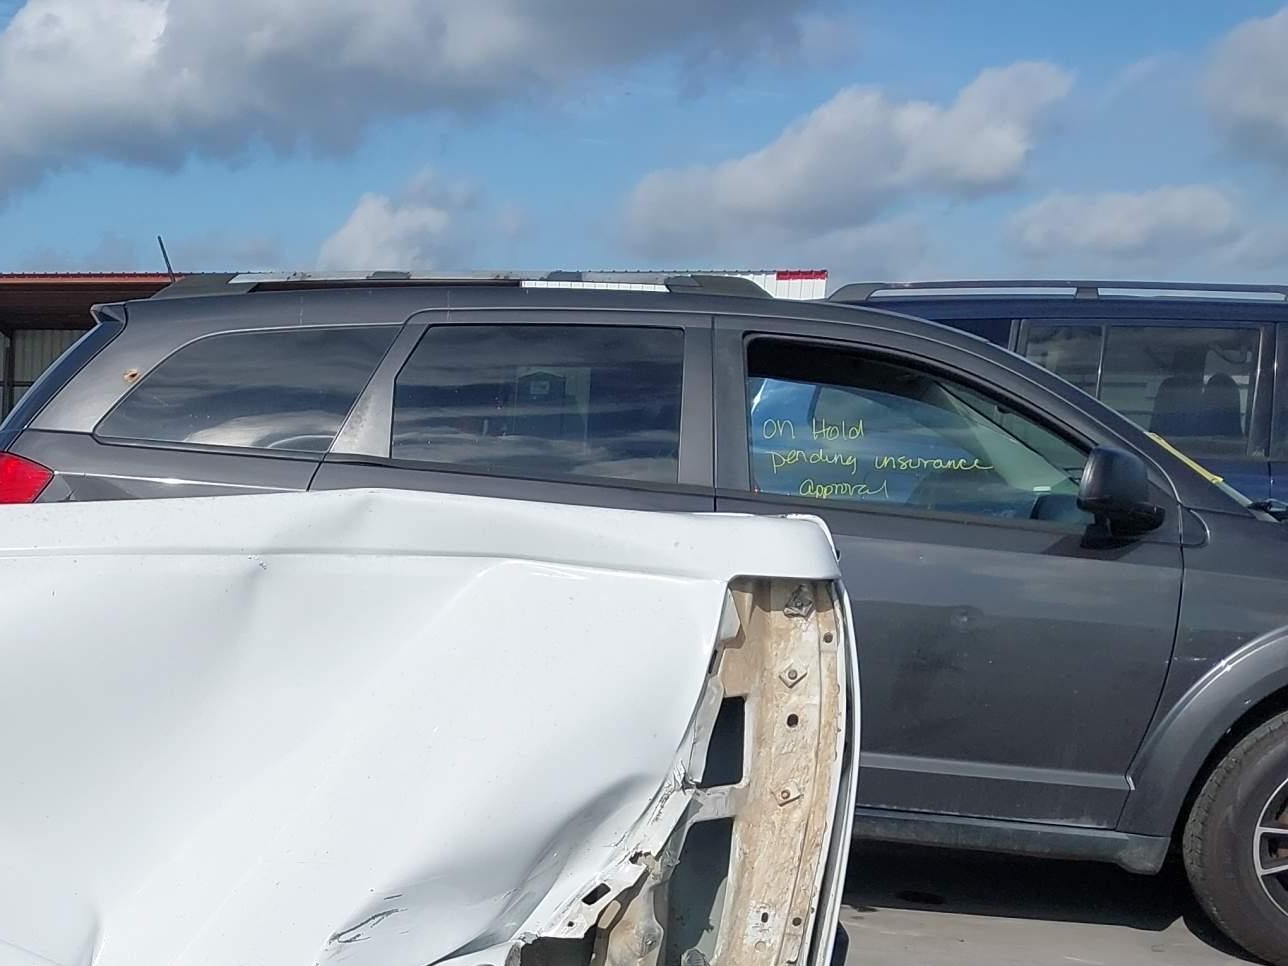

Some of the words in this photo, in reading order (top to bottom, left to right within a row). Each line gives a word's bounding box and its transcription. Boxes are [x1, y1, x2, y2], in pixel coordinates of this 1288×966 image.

[812, 417, 864, 441] Hold
[770, 448, 857, 474] pending
[874, 455, 994, 470] insurance
